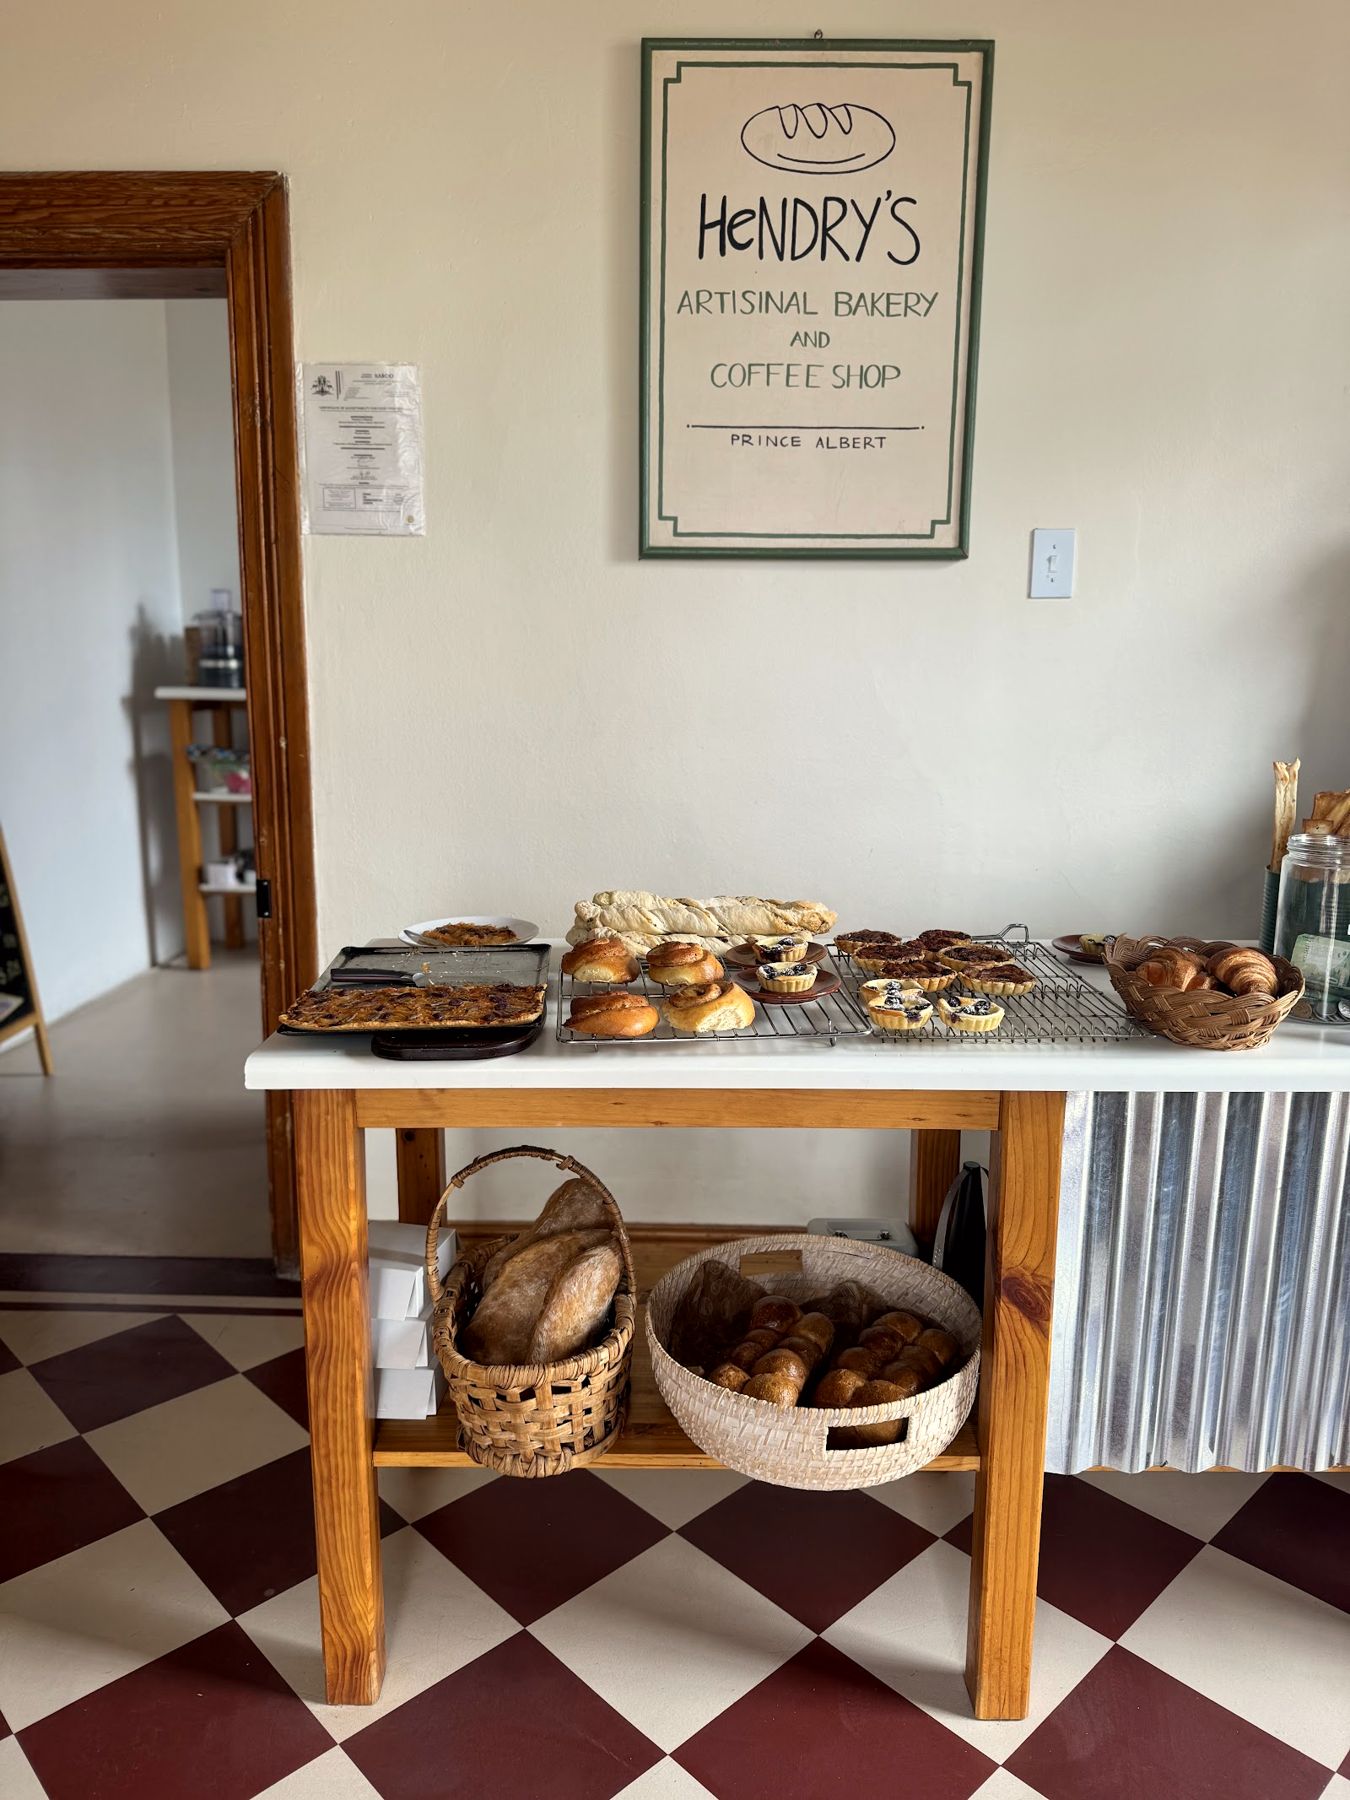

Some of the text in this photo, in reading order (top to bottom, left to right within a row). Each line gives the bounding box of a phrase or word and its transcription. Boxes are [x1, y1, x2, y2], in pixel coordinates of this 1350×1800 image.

[677, 289, 938, 317] ARTISINAL BAKERY
[790, 331, 830, 348] AND
[711, 363, 902, 389] COFFEE SHOP
[731, 434, 886, 449] PRINCE ALBERT
